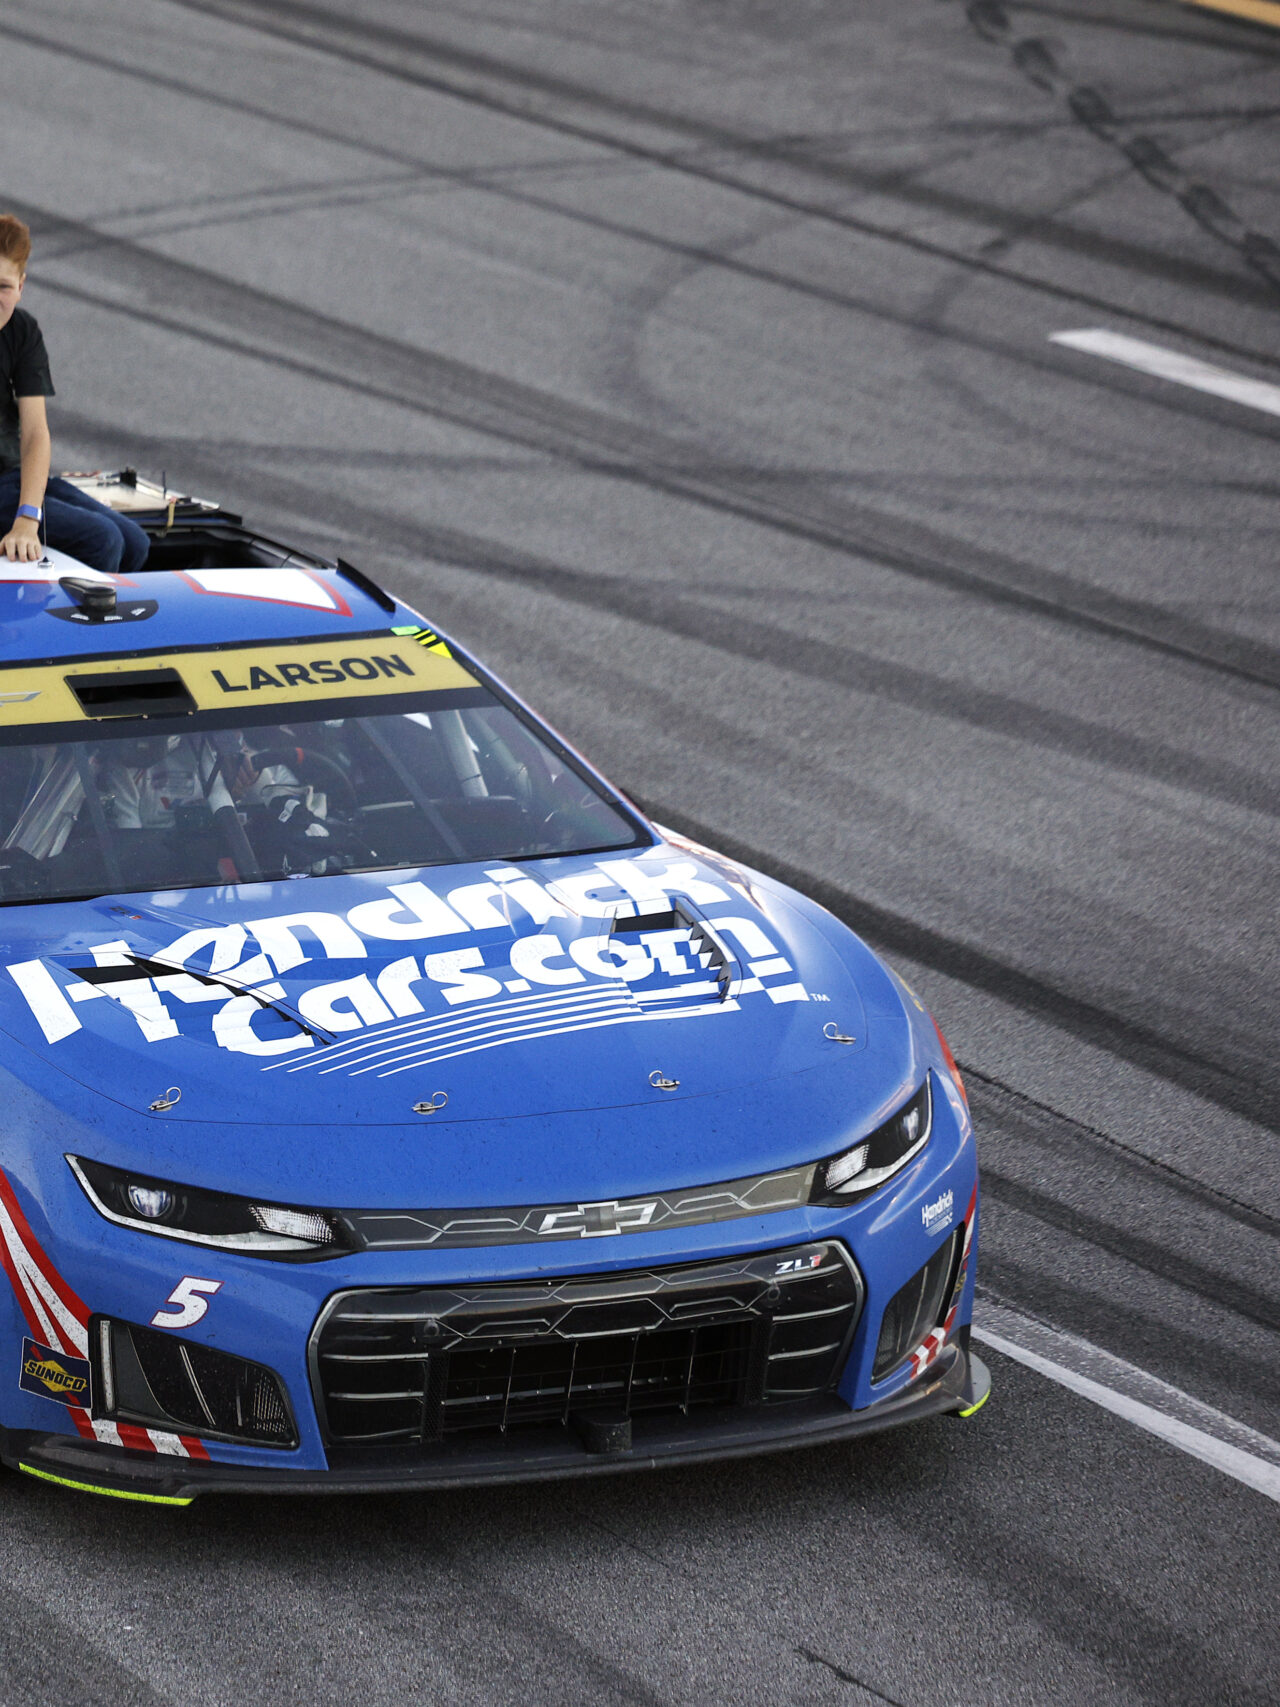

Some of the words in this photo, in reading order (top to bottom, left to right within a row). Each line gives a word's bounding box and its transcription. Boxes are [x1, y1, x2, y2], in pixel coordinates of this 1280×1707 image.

[211, 654, 416, 693] LARSON
[6, 859, 732, 1045] Hendrick
[775, 1254, 820, 1274] ZL1
[149, 1275, 224, 1329] 5
[26, 1361, 84, 1391] SUNOCO
